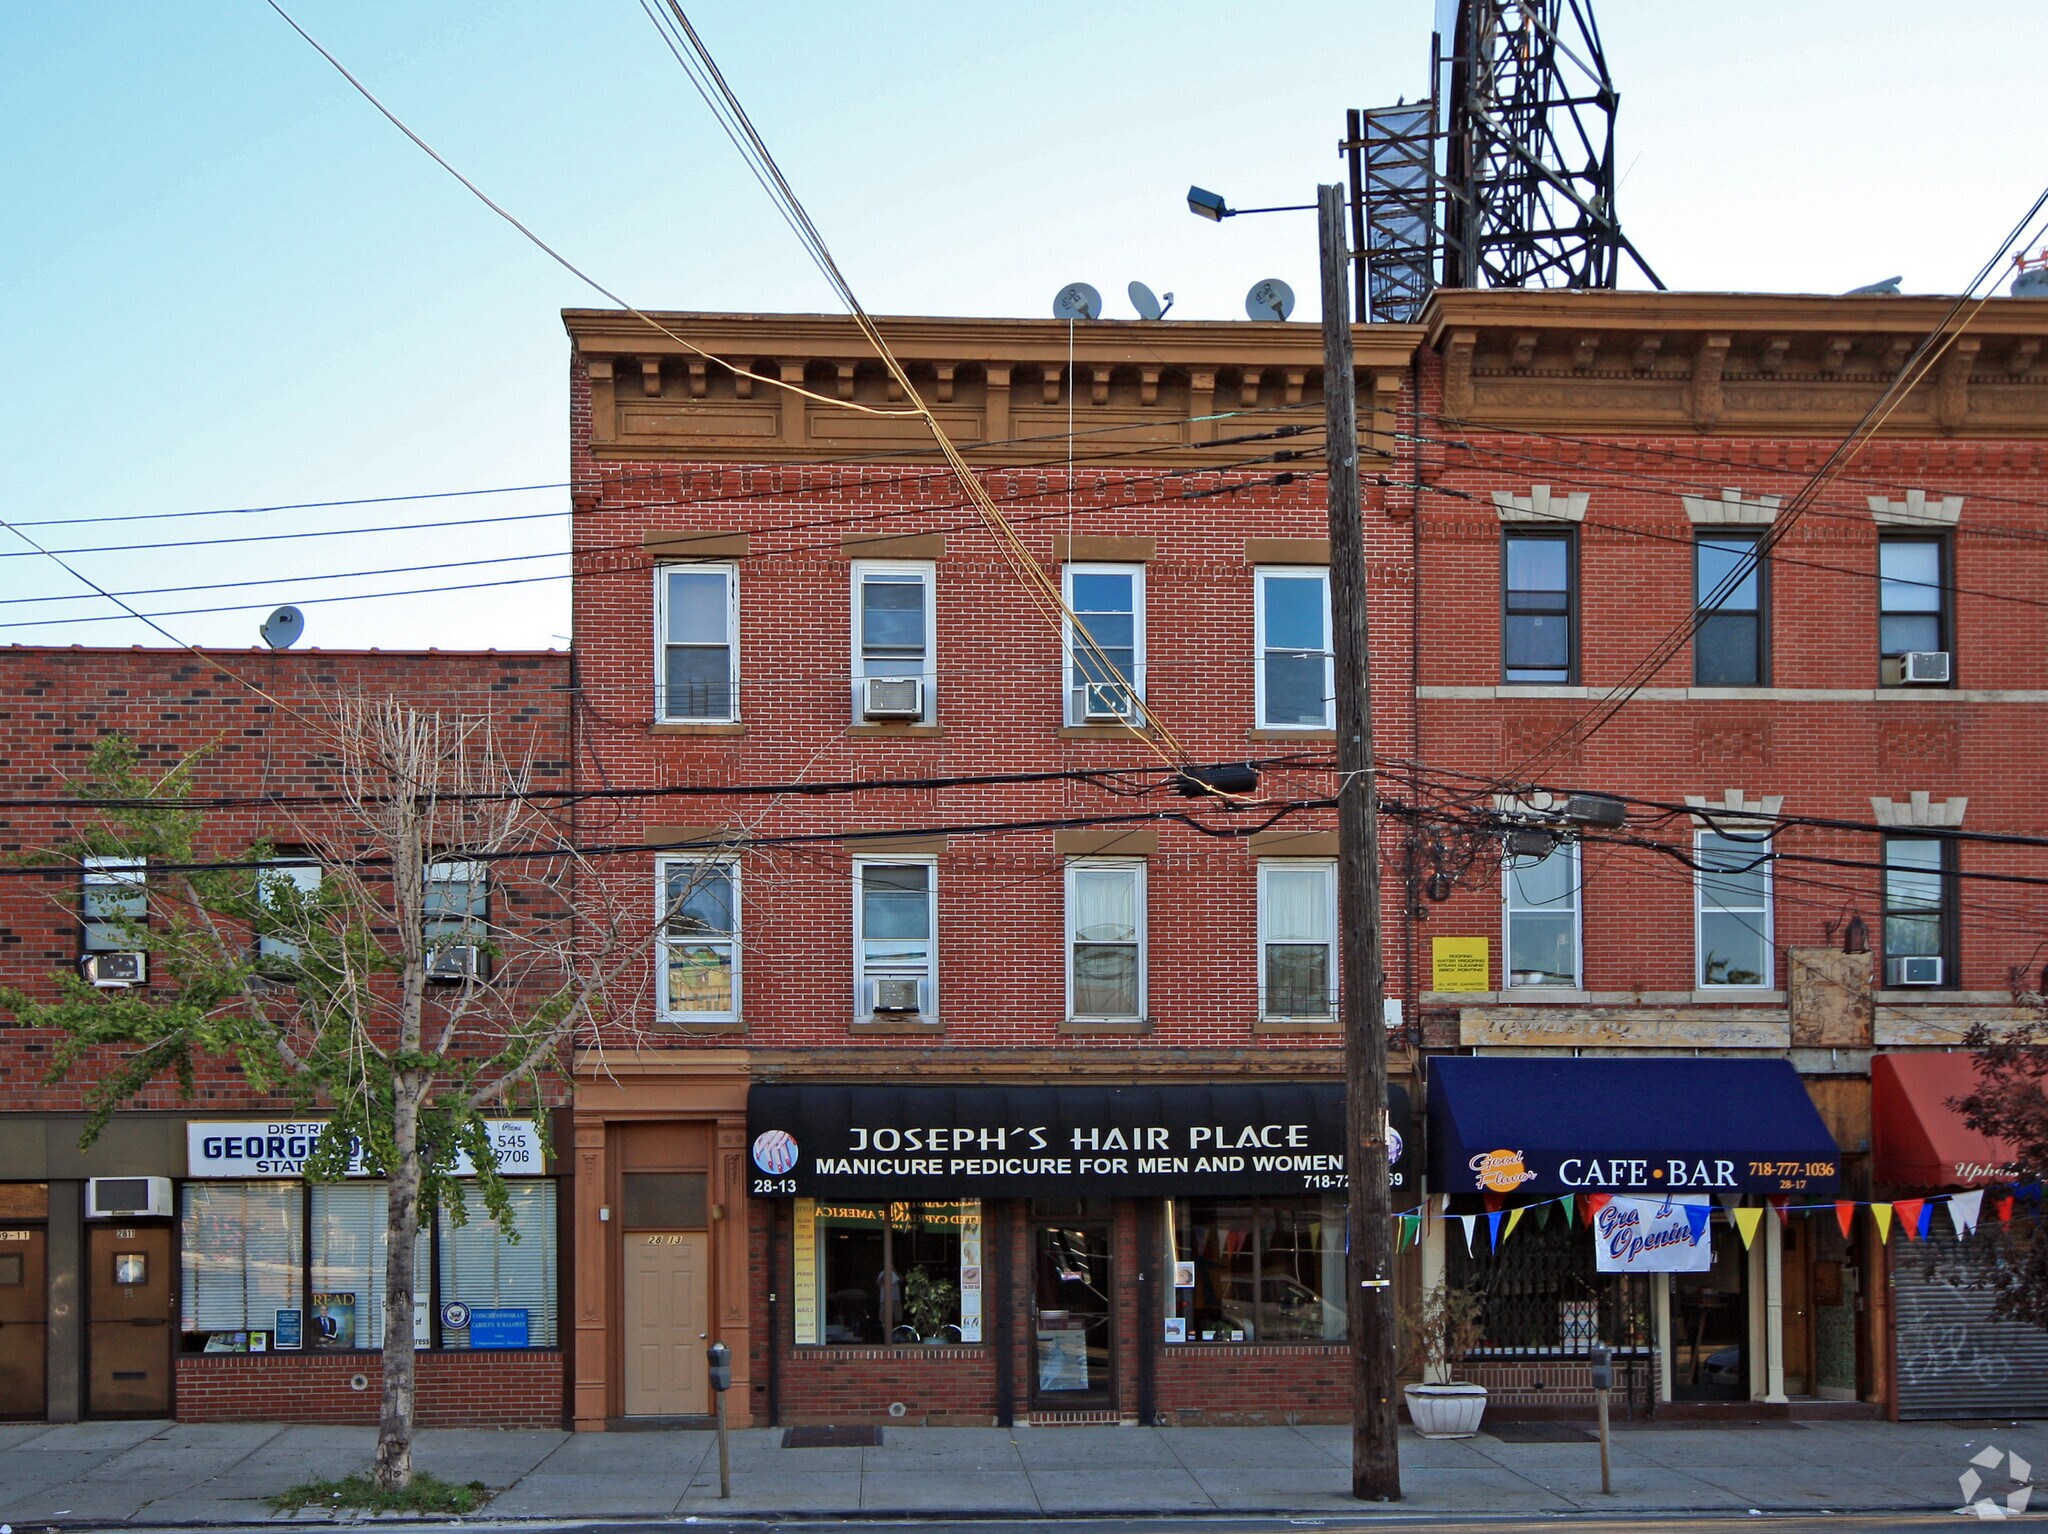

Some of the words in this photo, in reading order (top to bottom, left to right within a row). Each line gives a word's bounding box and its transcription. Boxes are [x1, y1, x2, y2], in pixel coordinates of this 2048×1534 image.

[498, 1136, 525, 1147] 545
[1070, 1127, 1169, 1150] HAIR
[1190, 1125, 1308, 1149] PLACE
[816, 1159, 943, 1175] MANICURE
[950, 1158, 1071, 1175] PEDICURE
[1080, 1158, 1128, 1174] FOR
[1138, 1157, 1189, 1173] MEN
[1194, 1156, 1245, 1172] AND
[1252, 1155, 1344, 1171] WOMEN
[1469, 1150, 1524, 1171] Good
[1559, 1159, 1648, 1186] CAFE
[1667, 1159, 1738, 1186] BAR
[1749, 1162, 1835, 1177] 718-777-1036
[754, 1180, 796, 1193] 28-13
[1475, 1170, 1538, 1190] Flavor
[1780, 1180, 1806, 1189] 28-17
[649, 1236, 662, 1244] 28
[670, 1236, 681, 1244] 13
[313, 1294, 355, 1306] READ
